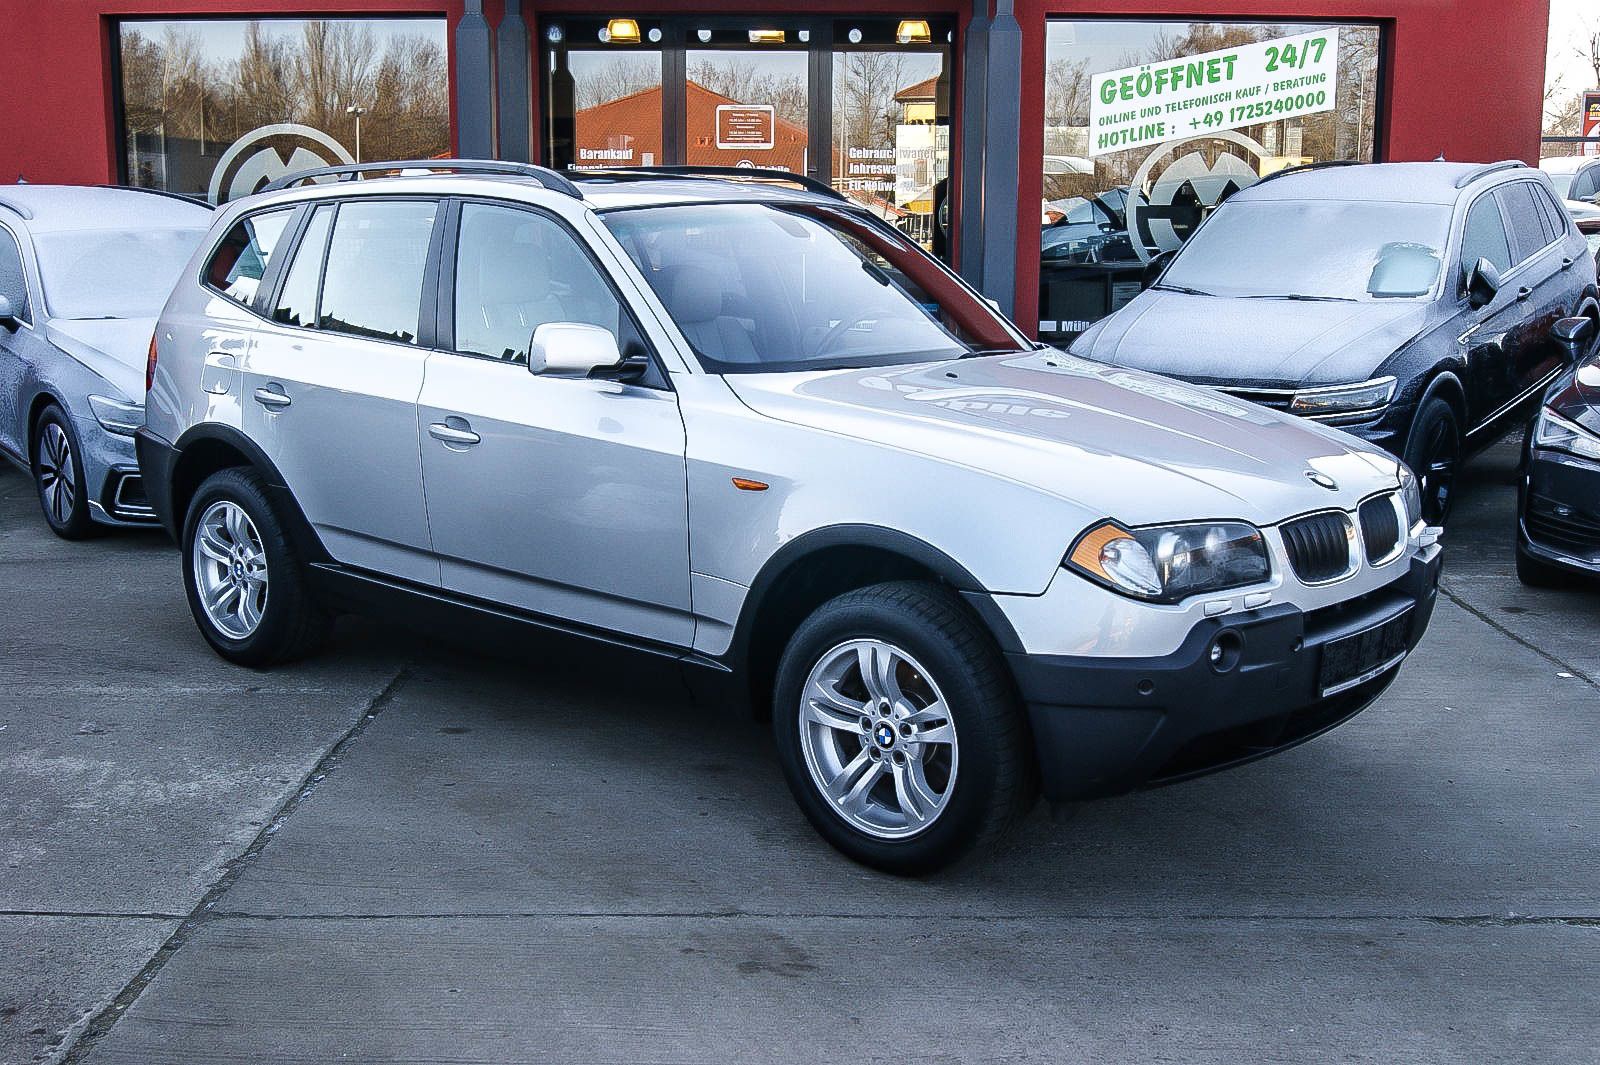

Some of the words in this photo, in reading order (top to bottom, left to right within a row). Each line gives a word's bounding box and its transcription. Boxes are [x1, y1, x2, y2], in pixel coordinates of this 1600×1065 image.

[1100, 55, 1238, 104] GEÖFFNET
[1265, 37, 1327, 72] 24/7
[1098, 111, 1137, 126] ONLINE
[1140, 105, 1162, 118] UND
[1166, 92, 1232, 114] TELEFONISCH
[1235, 85, 1262, 99] KAUF
[1273, 72, 1326, 93] BERATUNG
[1098, 122, 1166, 149] HOTLINE
[1189, 109, 1225, 130] +49
[1229, 90, 1326, 124] 1725240000
[580, 148, 633, 160] Barankauf
